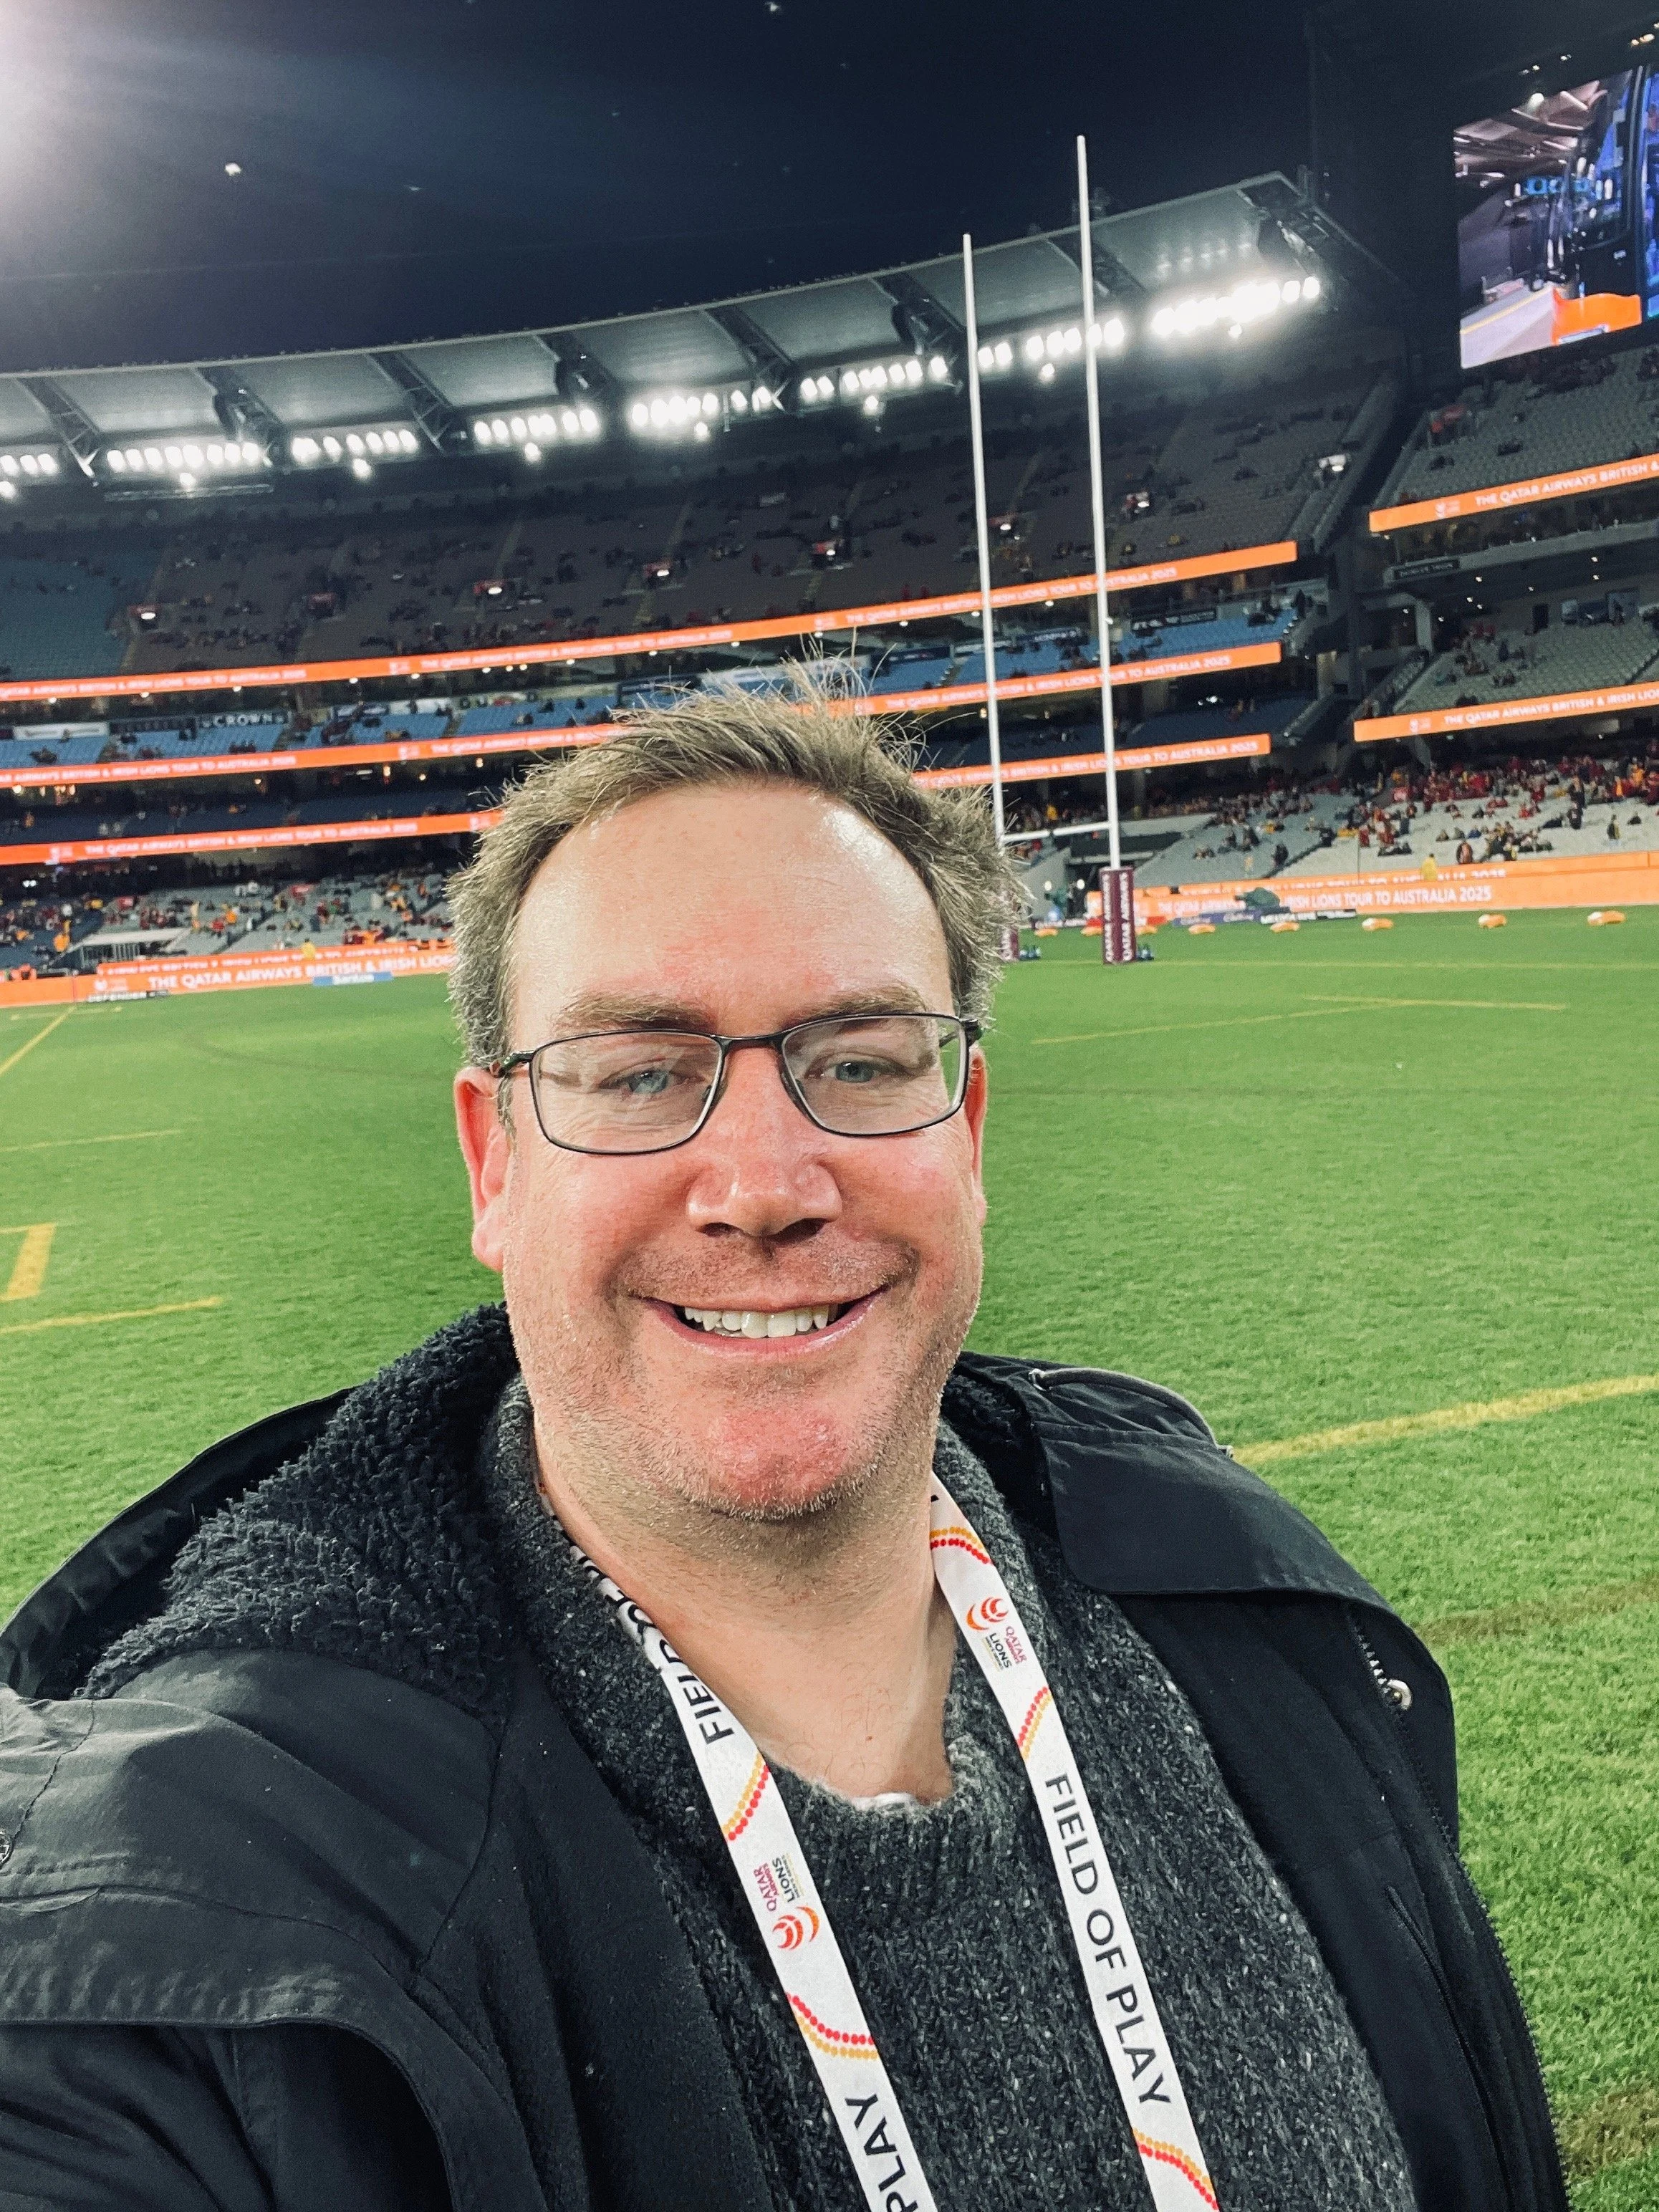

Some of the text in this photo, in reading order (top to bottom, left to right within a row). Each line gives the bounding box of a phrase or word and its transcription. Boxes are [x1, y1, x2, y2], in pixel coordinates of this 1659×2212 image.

[1476, 493, 1496, 506] THE
[1500, 484, 1538, 503] QATAR
[1541, 473, 1595, 494] AIRWAYS
[1599, 462, 1646, 482] BRITISH
[1444, 713, 1463, 725] THE
[1466, 708, 1499, 724] QATAR
[1503, 702, 1549, 718] AIRWAYS
[1552, 697, 1593, 711] BRITISH
[1607, 691, 1635, 704] IRISH
[1312, 893, 1342, 908] LIONS
[1344, 890, 1372, 906] TOUR
[1375, 889, 1391, 905] TO
[1393, 888, 1456, 903] AUSTRALIA
[1459, 885, 1491, 902] 2025
[1121, 922, 1133, 961] QATAR
[148, 975, 178, 989] THE
[181, 971, 232, 989] QATAR
[236, 966, 302, 983] AIRWAYS
[306, 961, 362, 976] BRITISH
[365, 960, 375, 973] &
[379, 956, 416, 972] IRISH
[989, 1632, 1012, 1668] LIONS
[1006, 1625, 1027, 1663] QATAR
[754, 1865, 776, 1911] QATAR
[772, 1857, 795, 1903] LIONS
[1045, 1773, 1172, 2104] FIELD OF PLAY
[845, 2094, 918, 2212] PLAY
